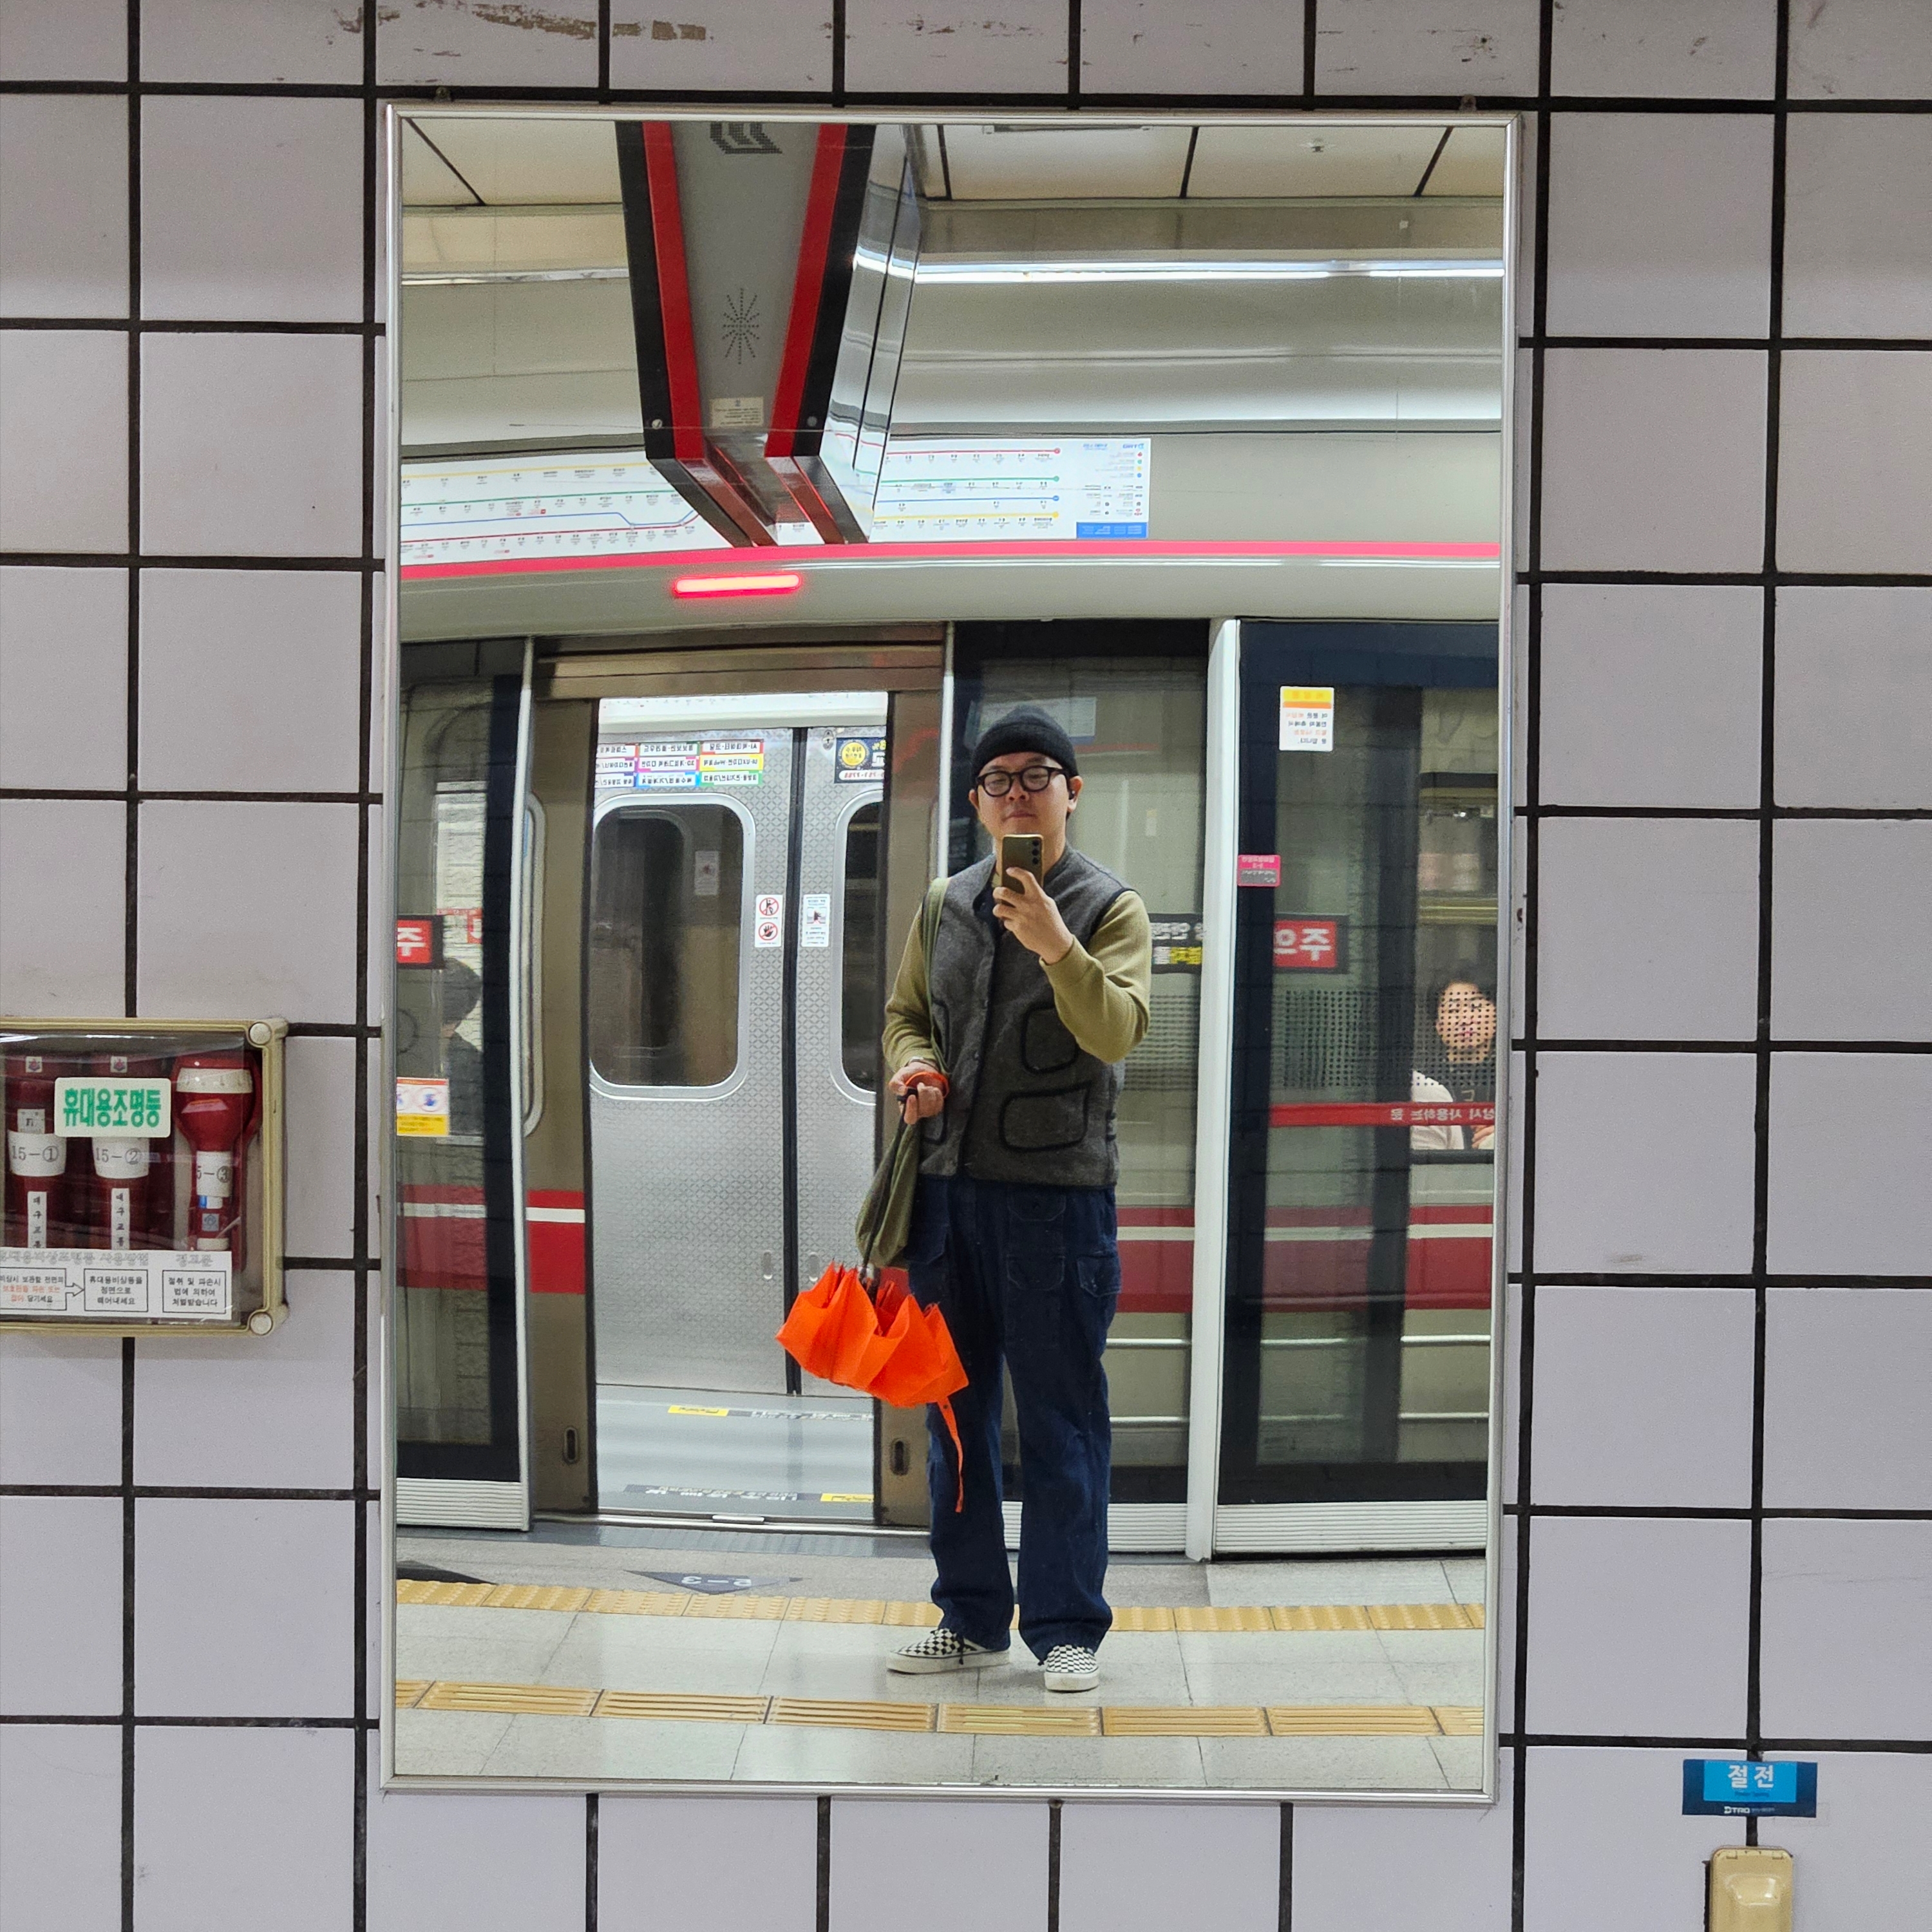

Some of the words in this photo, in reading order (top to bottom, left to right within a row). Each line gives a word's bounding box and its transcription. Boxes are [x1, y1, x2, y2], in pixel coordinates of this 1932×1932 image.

[63, 1088, 162, 1128] 휴대용조명등
[168, 1277, 183, 1285] 절취
[187, 1277, 194, 1286] 및
[198, 1277, 221, 1287] 파손시
[174, 1287, 189, 1296] 법에
[193, 1288, 216, 1296] 의하여
[172, 1298, 218, 1307] 처벌받습니다
